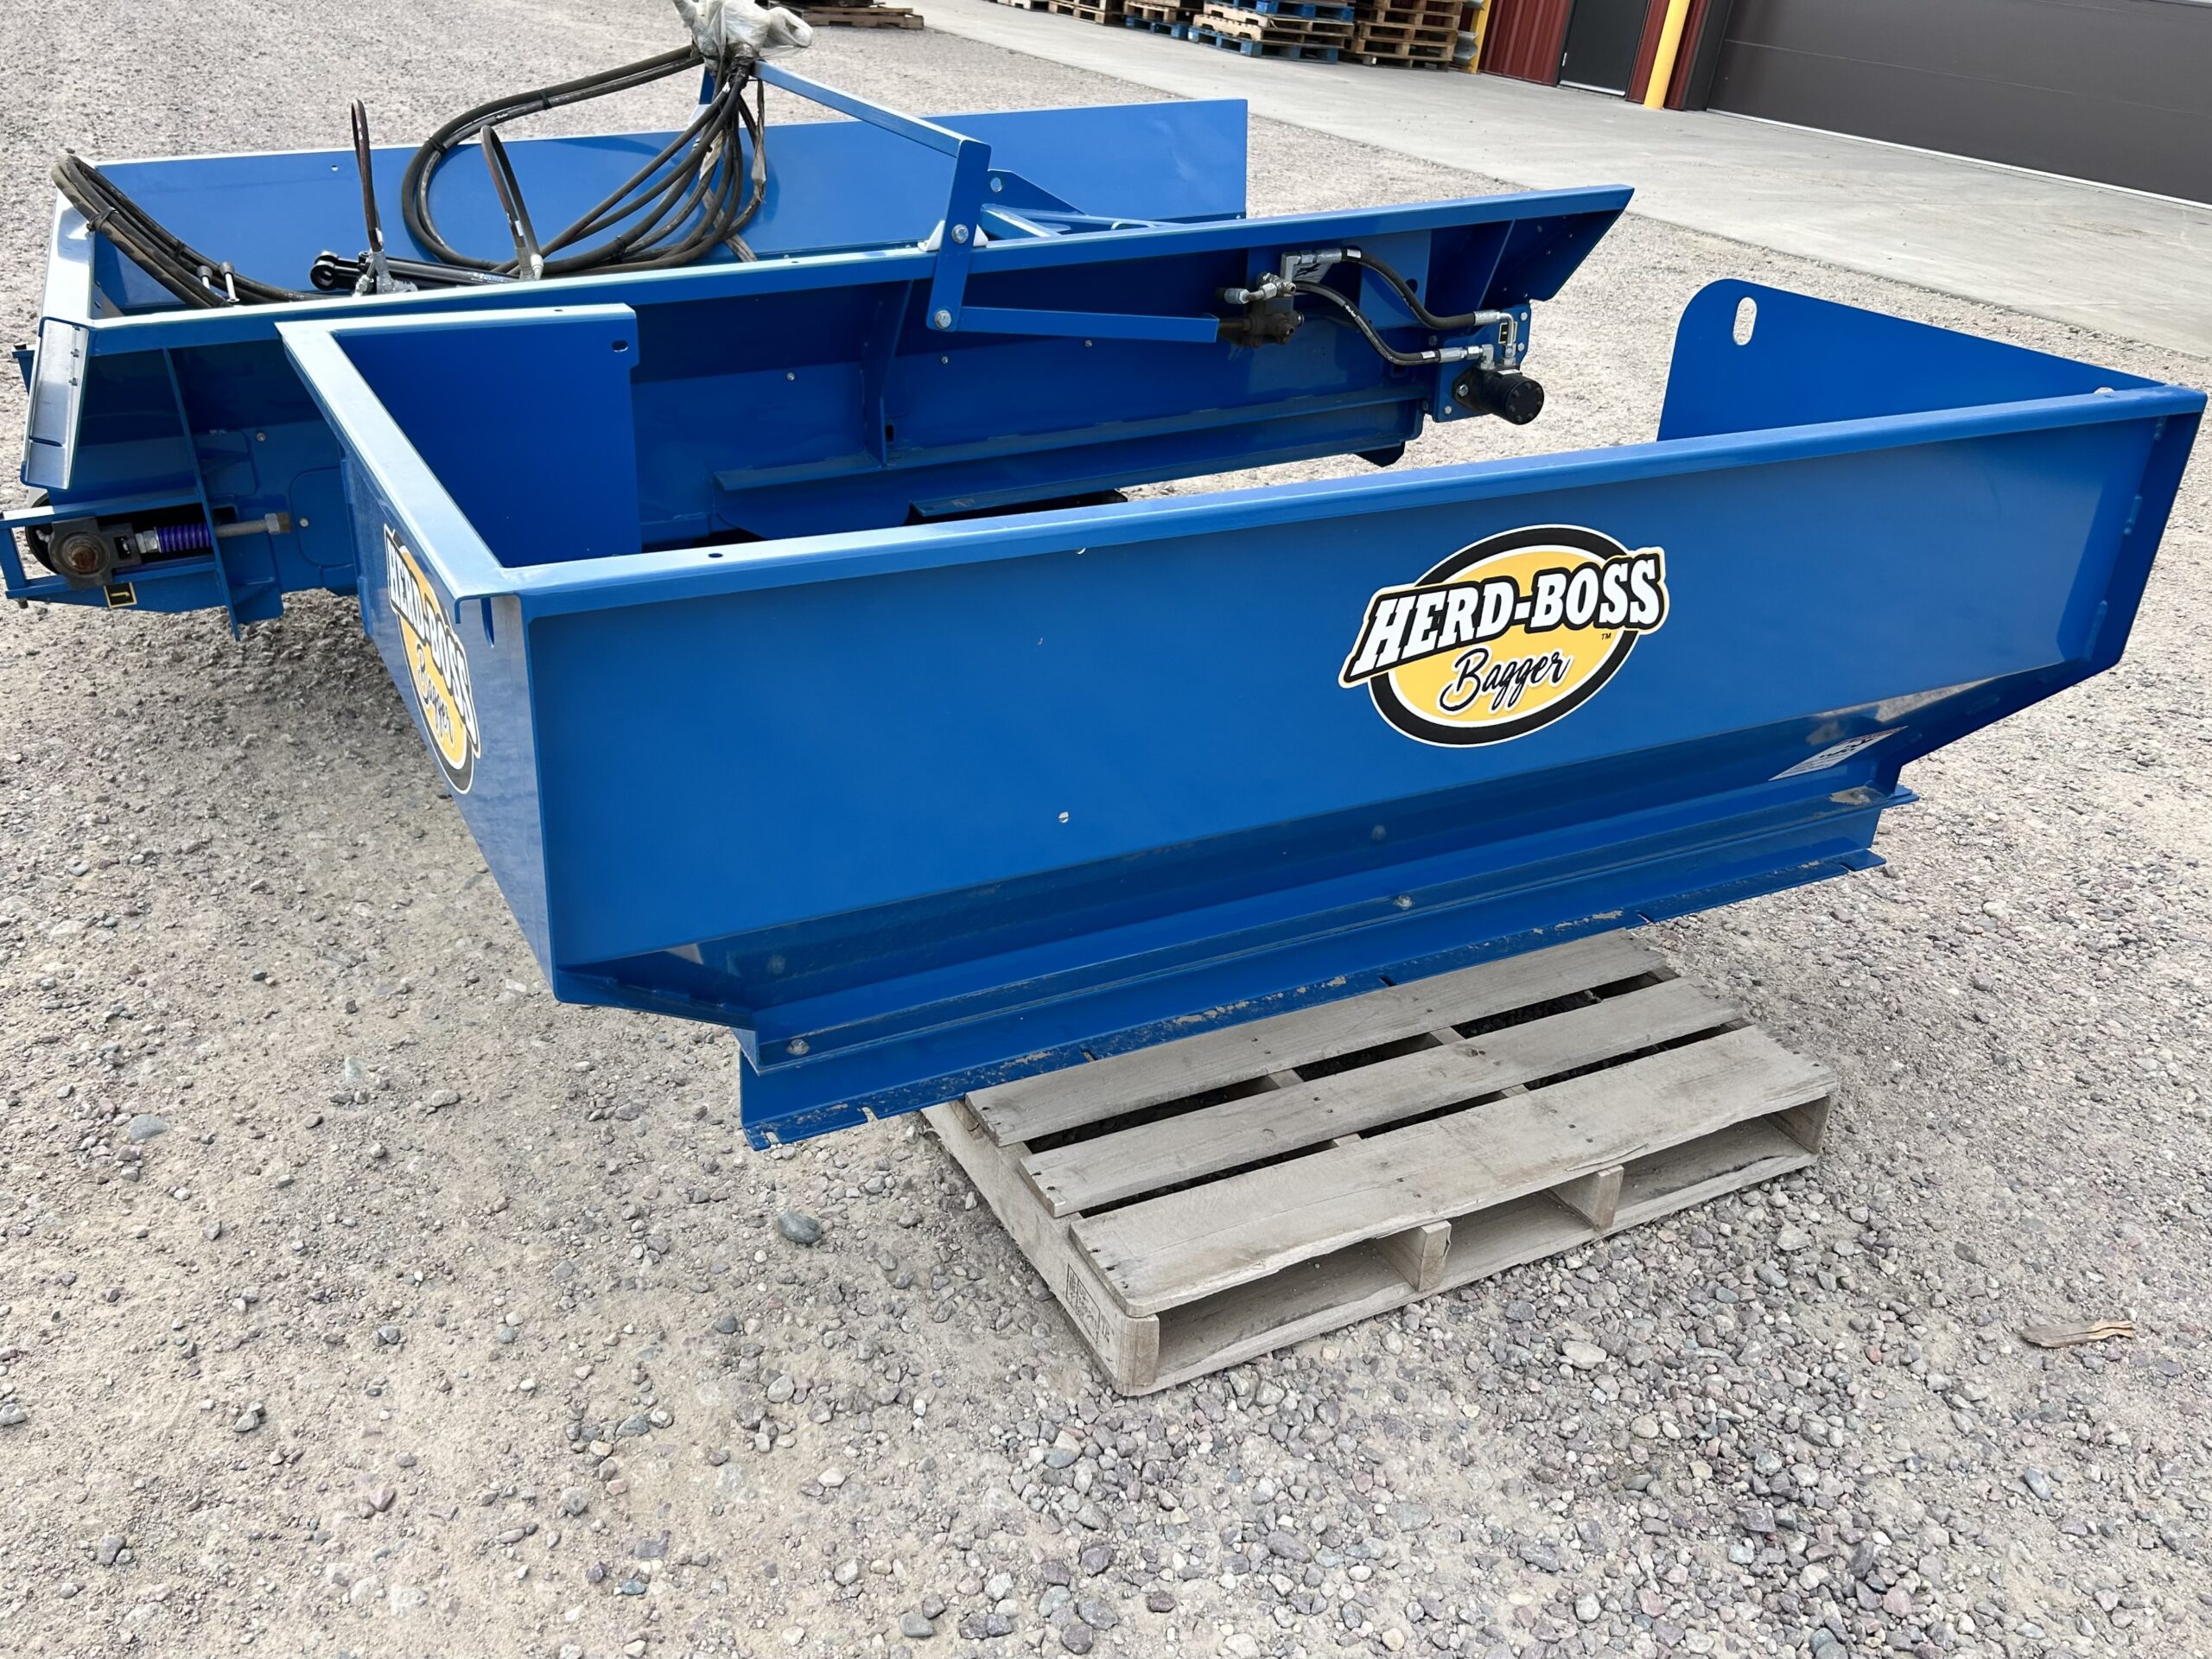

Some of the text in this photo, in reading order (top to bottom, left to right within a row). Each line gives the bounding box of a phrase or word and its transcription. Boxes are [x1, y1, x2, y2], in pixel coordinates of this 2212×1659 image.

[386, 535, 477, 746] HERD-BOSS
[1348, 557, 1661, 678] HERD-BOSS
[1601, 632, 1611, 640] TM
[1440, 648, 1569, 712] Bagger
